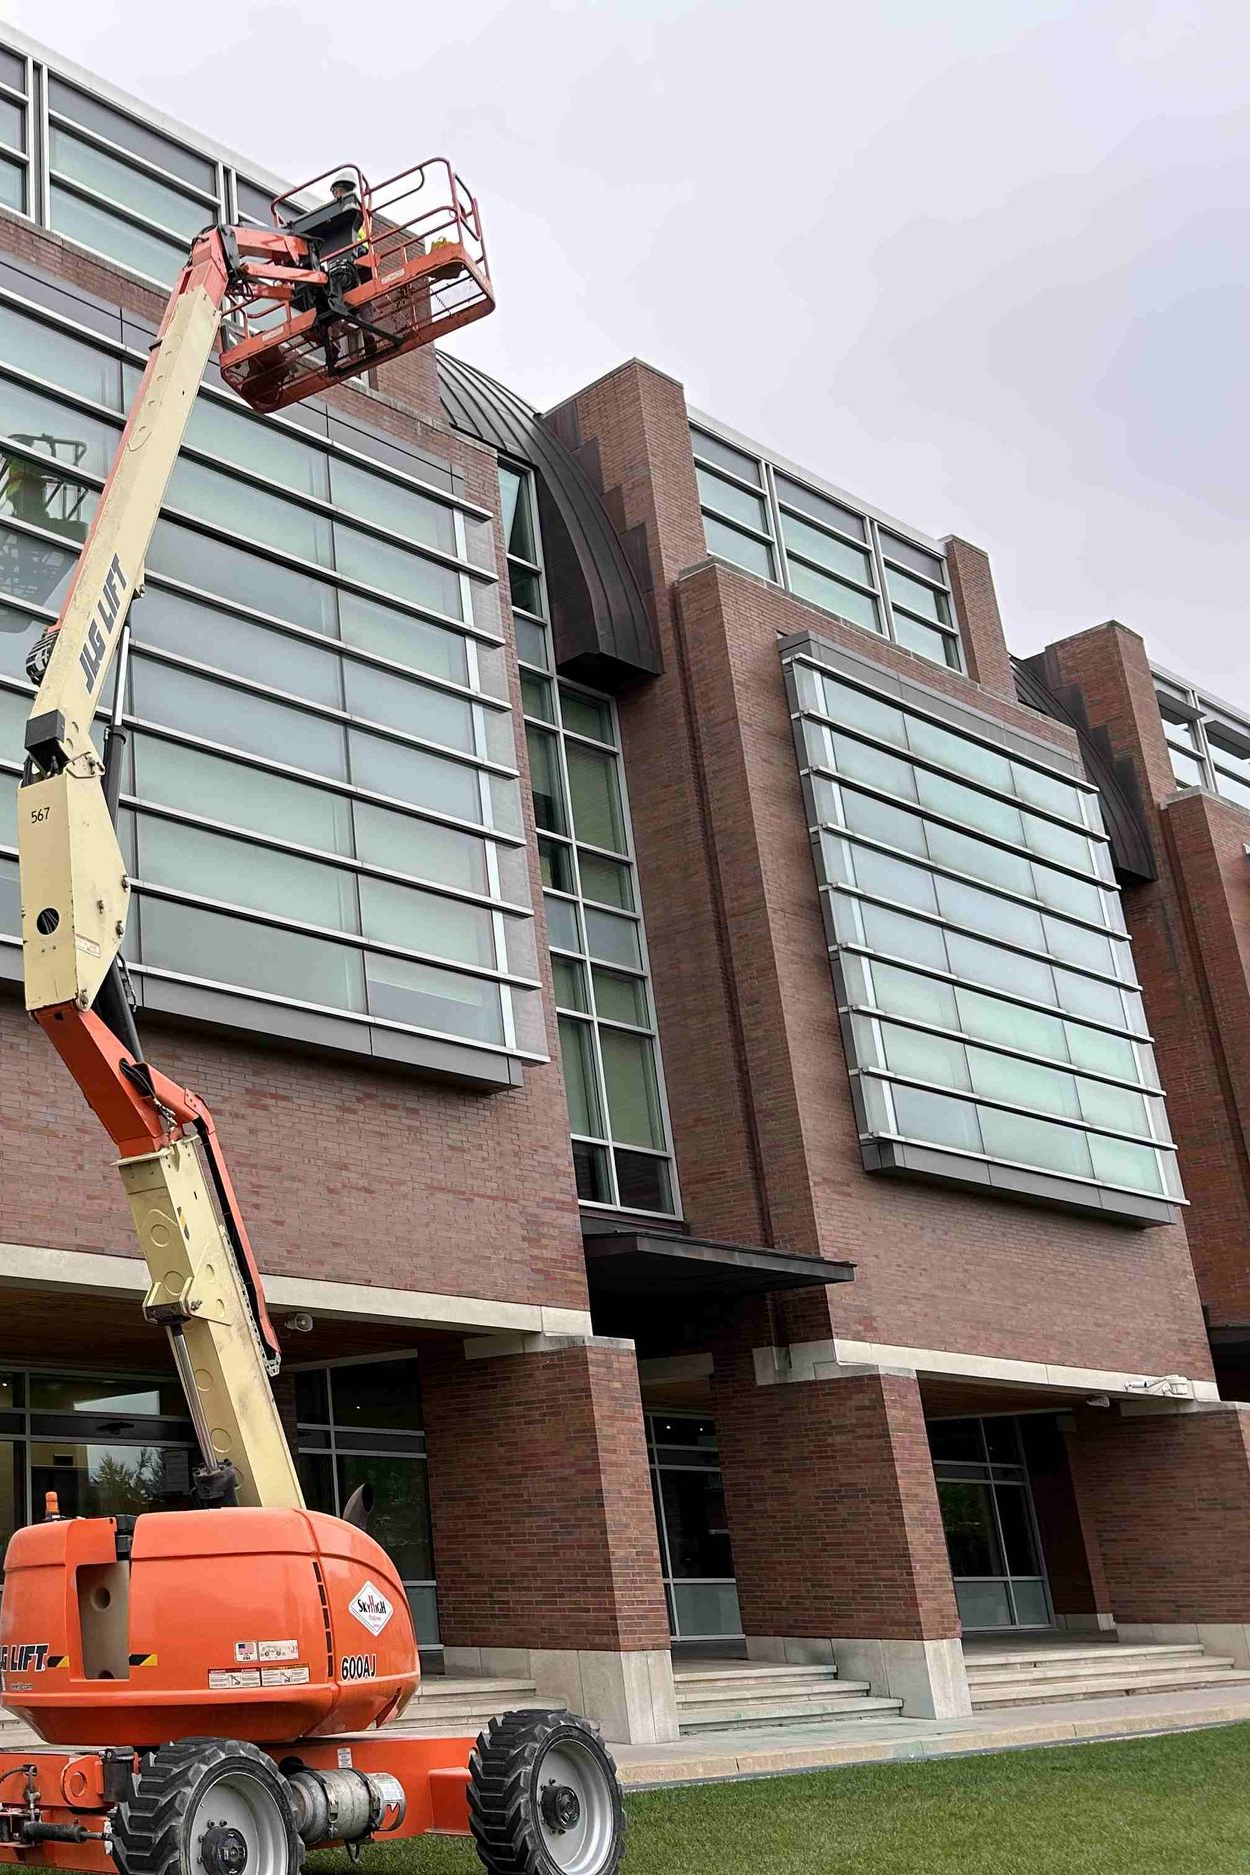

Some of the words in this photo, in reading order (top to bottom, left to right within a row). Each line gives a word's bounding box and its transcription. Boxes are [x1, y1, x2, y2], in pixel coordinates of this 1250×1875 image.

[79, 618, 106, 694] JLG
[97, 553, 127, 634] LIFT
[31, 806, 50, 824] 567
[10, 1643, 49, 1672] LIFT
[341, 1654, 376, 1680] 600AJ
